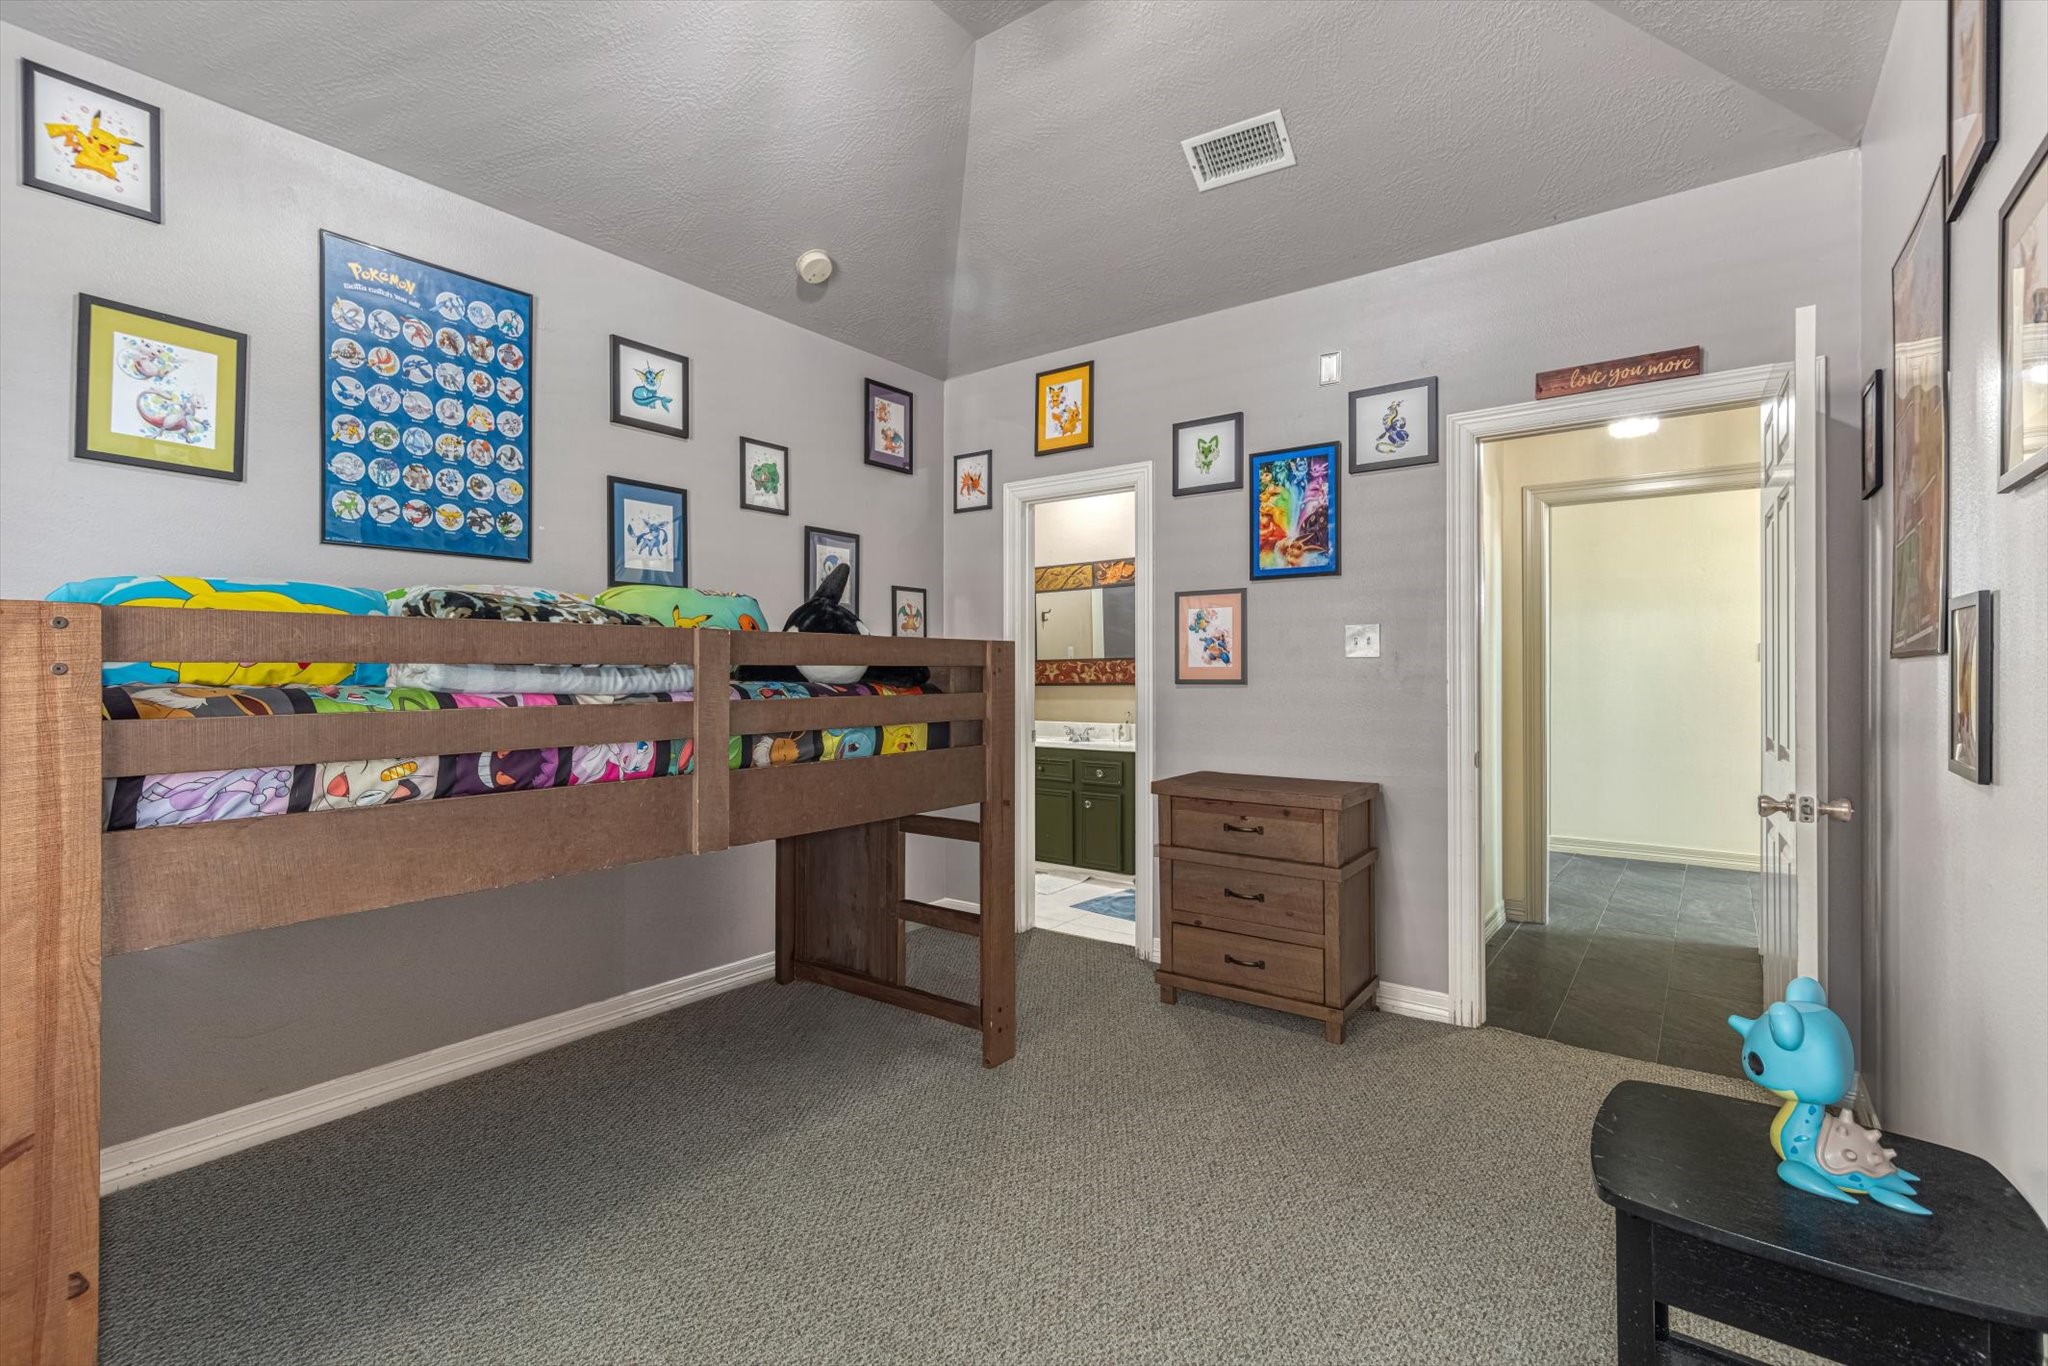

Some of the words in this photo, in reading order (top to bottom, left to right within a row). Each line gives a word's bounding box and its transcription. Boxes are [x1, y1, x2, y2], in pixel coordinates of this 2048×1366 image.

[1570, 368, 1606, 388] love
[1608, 367, 1644, 387] you
[1648, 358, 1693, 375] more
